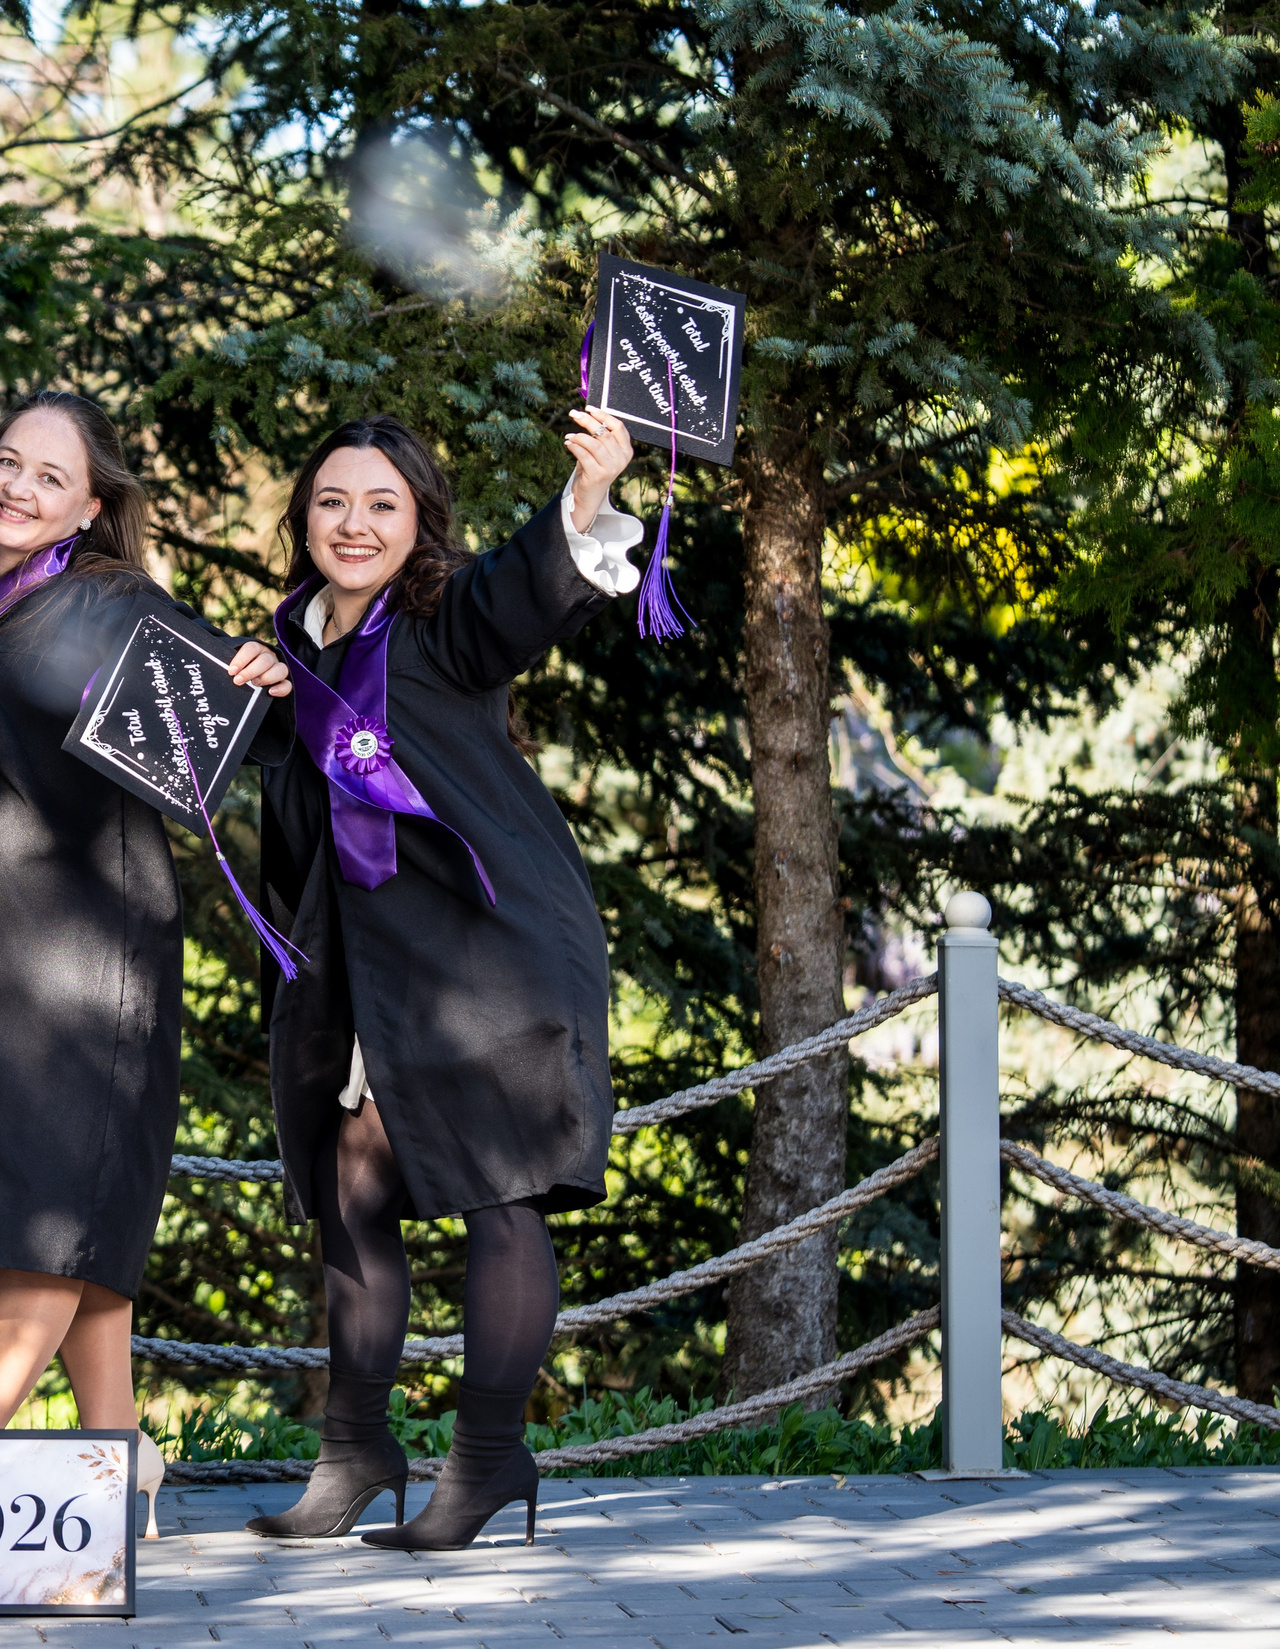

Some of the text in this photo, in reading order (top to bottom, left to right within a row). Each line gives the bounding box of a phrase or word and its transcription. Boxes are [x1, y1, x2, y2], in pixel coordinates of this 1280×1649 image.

[635, 305, 708, 406] este posibil când
[681, 317, 710, 352] Totul
[618, 338, 672, 414] crezi în tine!
[122, 708, 147, 747] Totul
[144, 658, 190, 774] este posibil când
[184, 663, 230, 749] crezi în tine!
